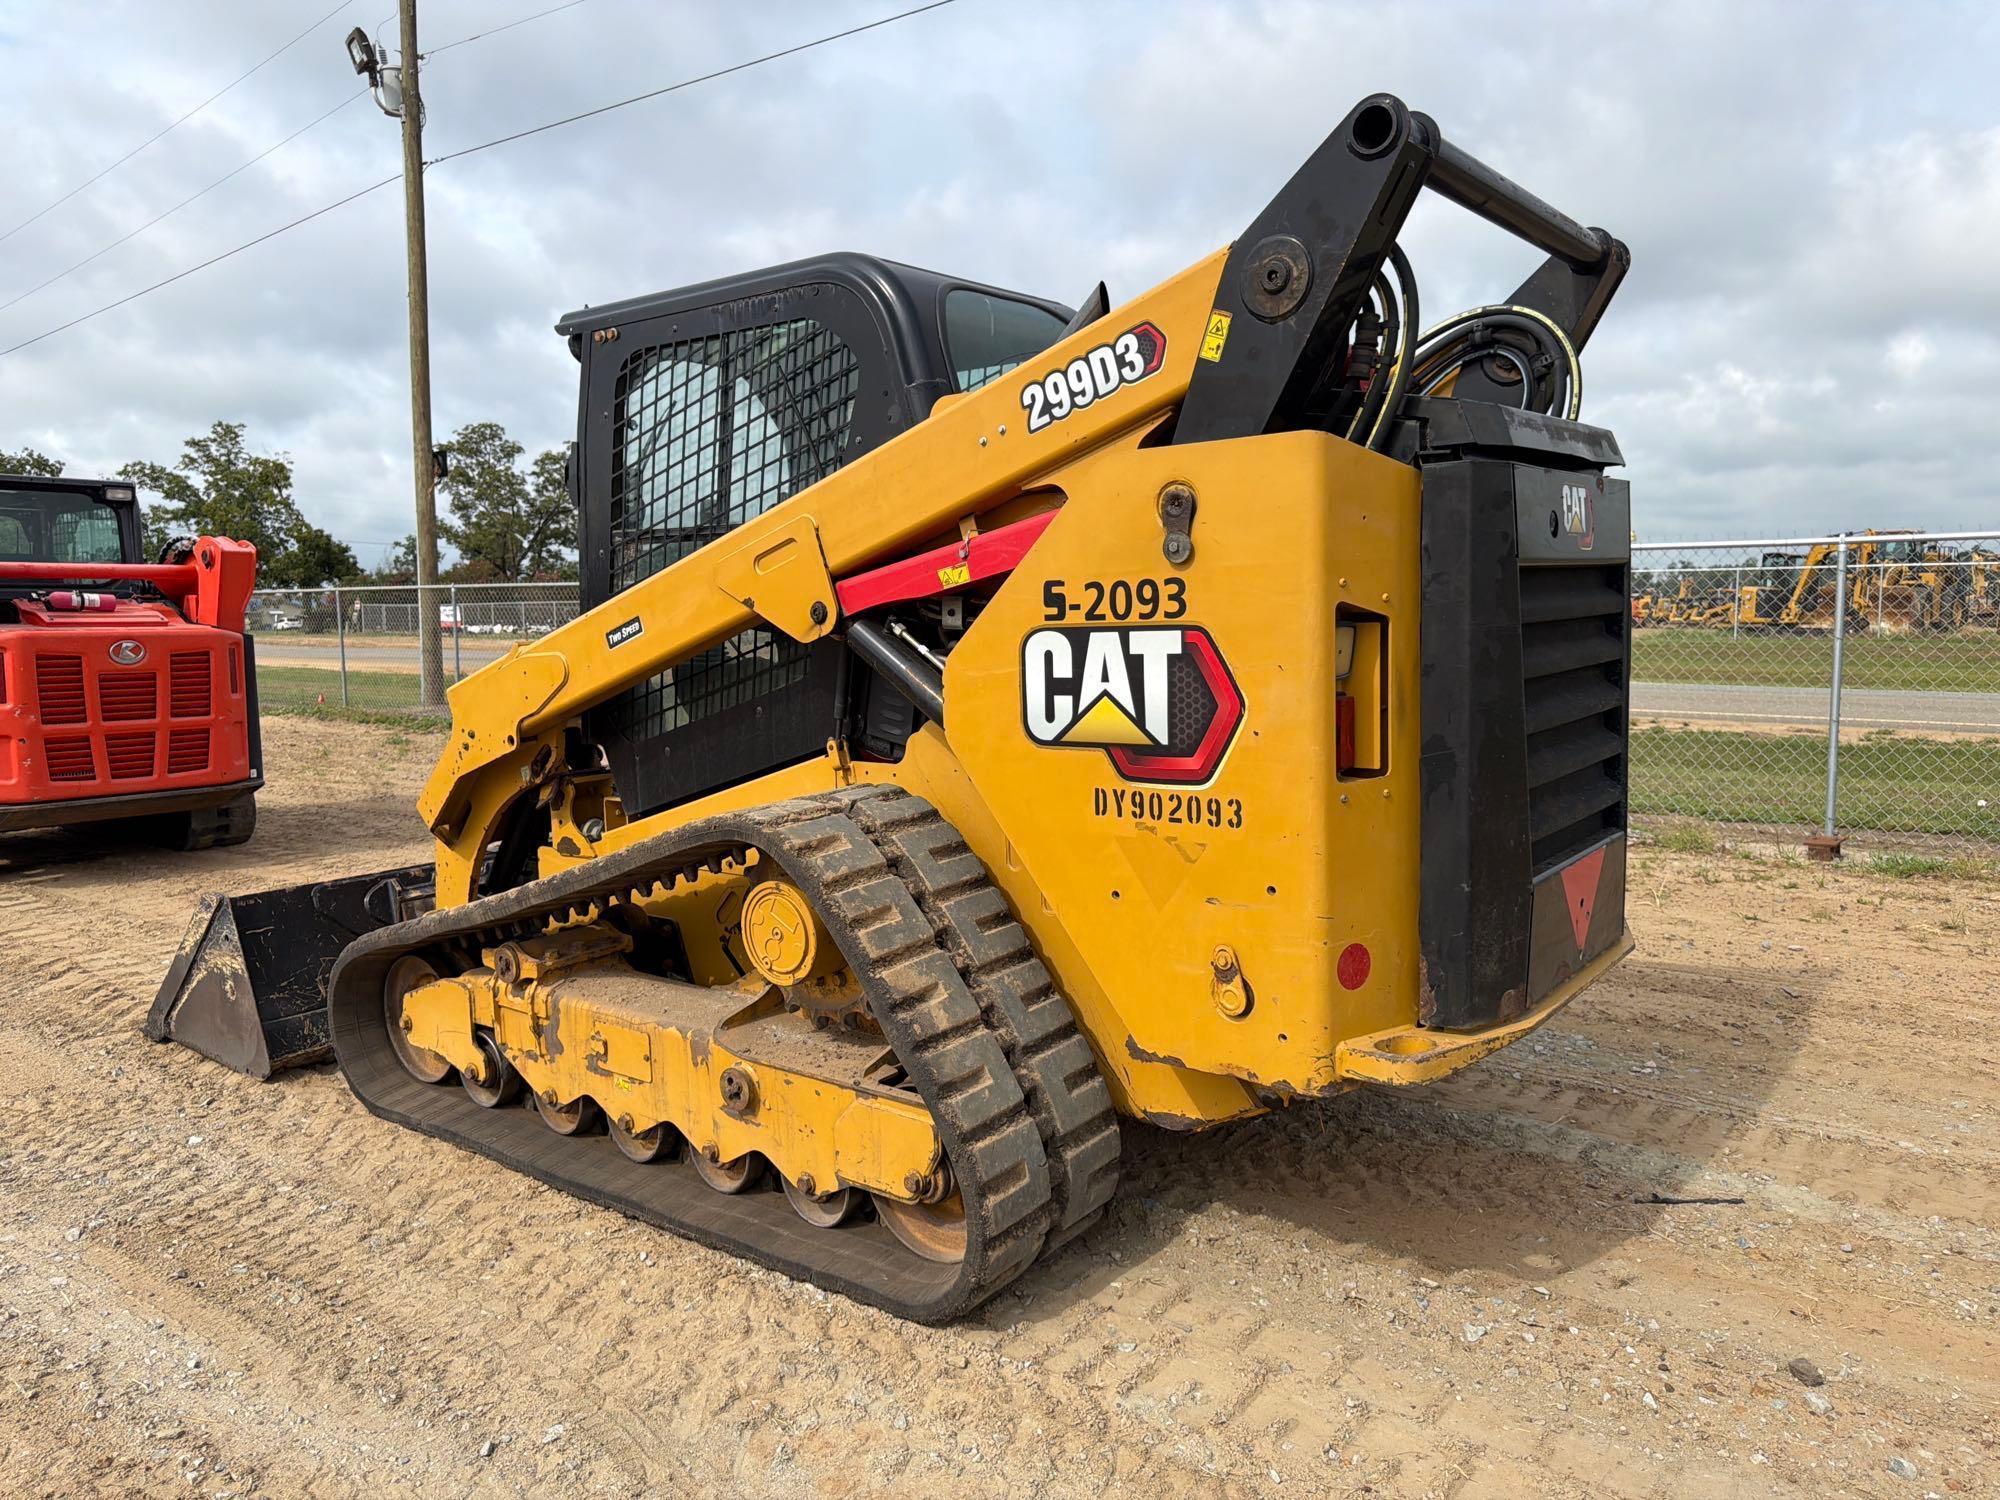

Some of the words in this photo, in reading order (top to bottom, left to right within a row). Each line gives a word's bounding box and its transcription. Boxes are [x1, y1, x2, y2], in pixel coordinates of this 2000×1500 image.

[1022, 333, 1144, 431] 299D3
[1562, 484, 1586, 533] CAT
[1043, 577, 1187, 622] S-2093
[1025, 630, 1182, 746] CAT
[1094, 787, 1242, 829] DY902093
